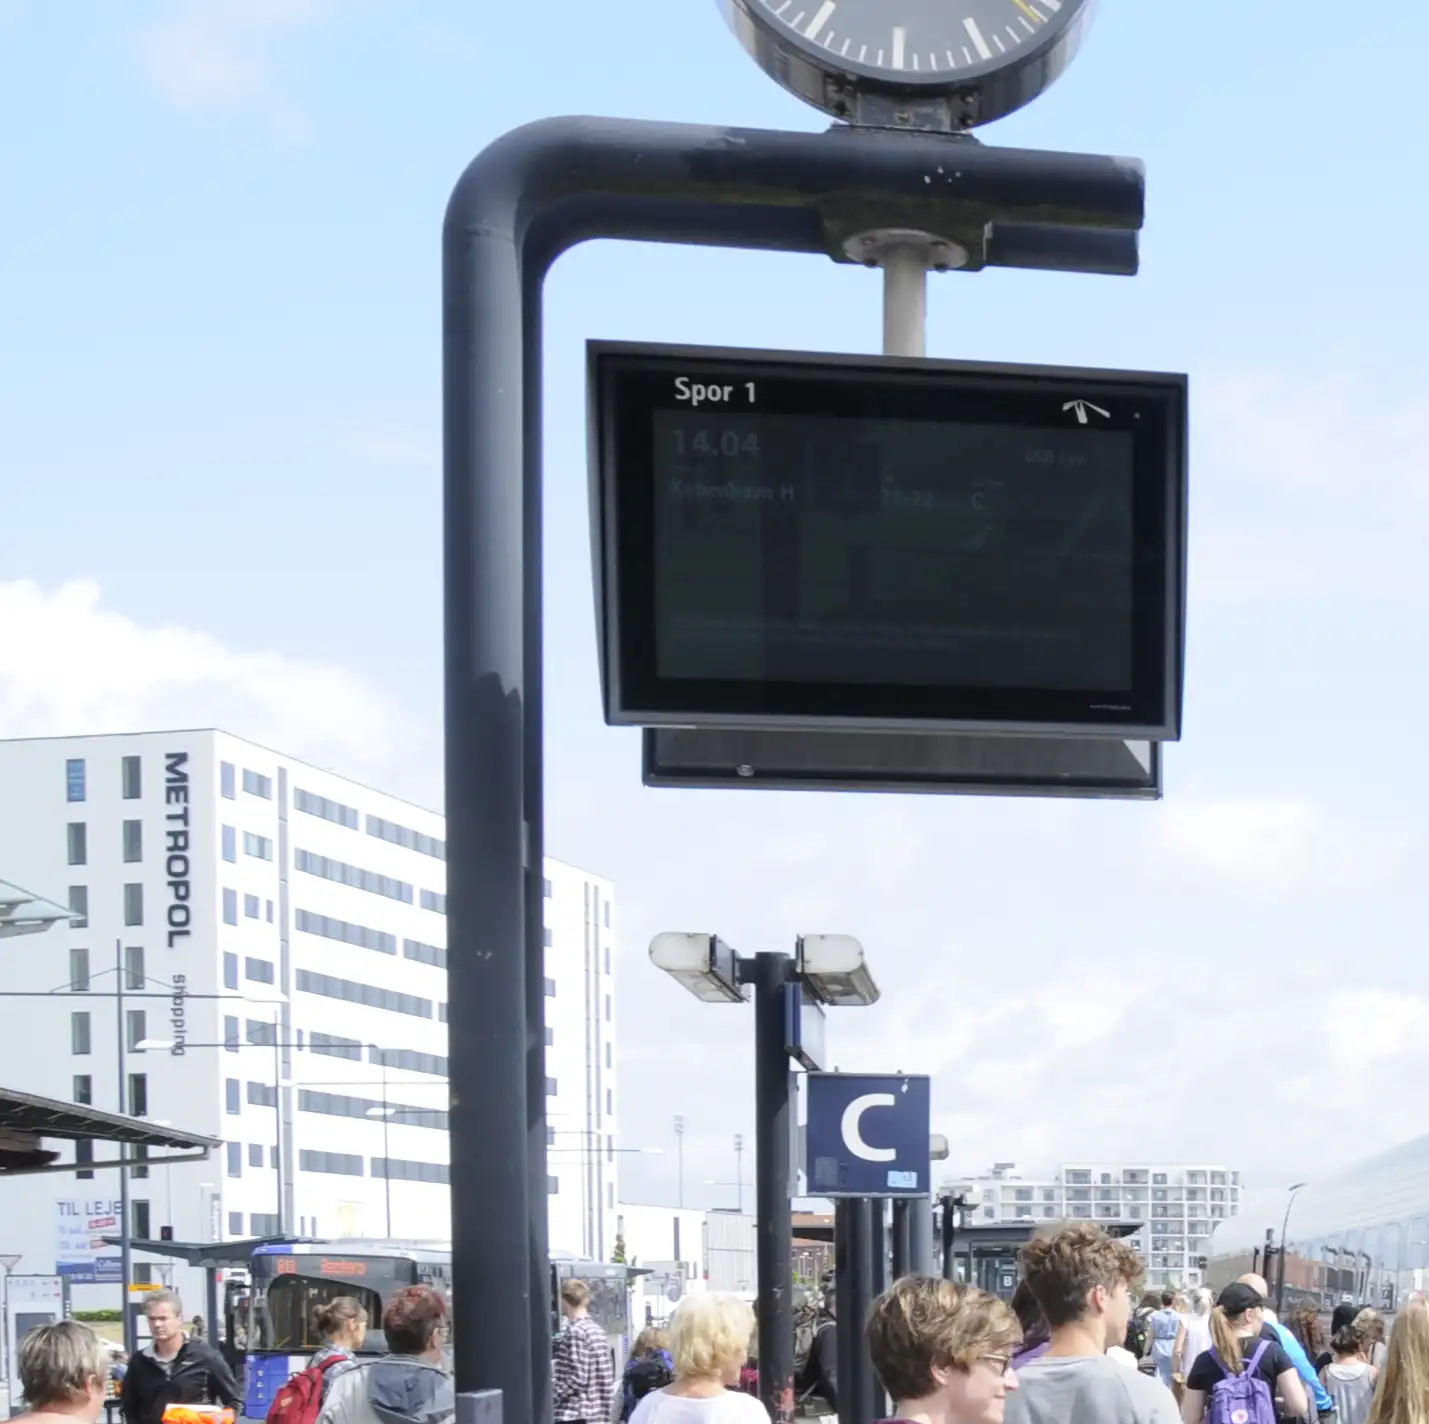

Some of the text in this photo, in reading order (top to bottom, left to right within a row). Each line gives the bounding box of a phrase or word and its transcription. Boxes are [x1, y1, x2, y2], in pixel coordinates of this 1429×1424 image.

[674, 376, 755, 407] Spor 1
[671, 428, 760, 456] 14.04
[164, 752, 191, 948] METROPOL
[841, 1093, 897, 1162] C
[57, 1201, 80, 1216] TIL
